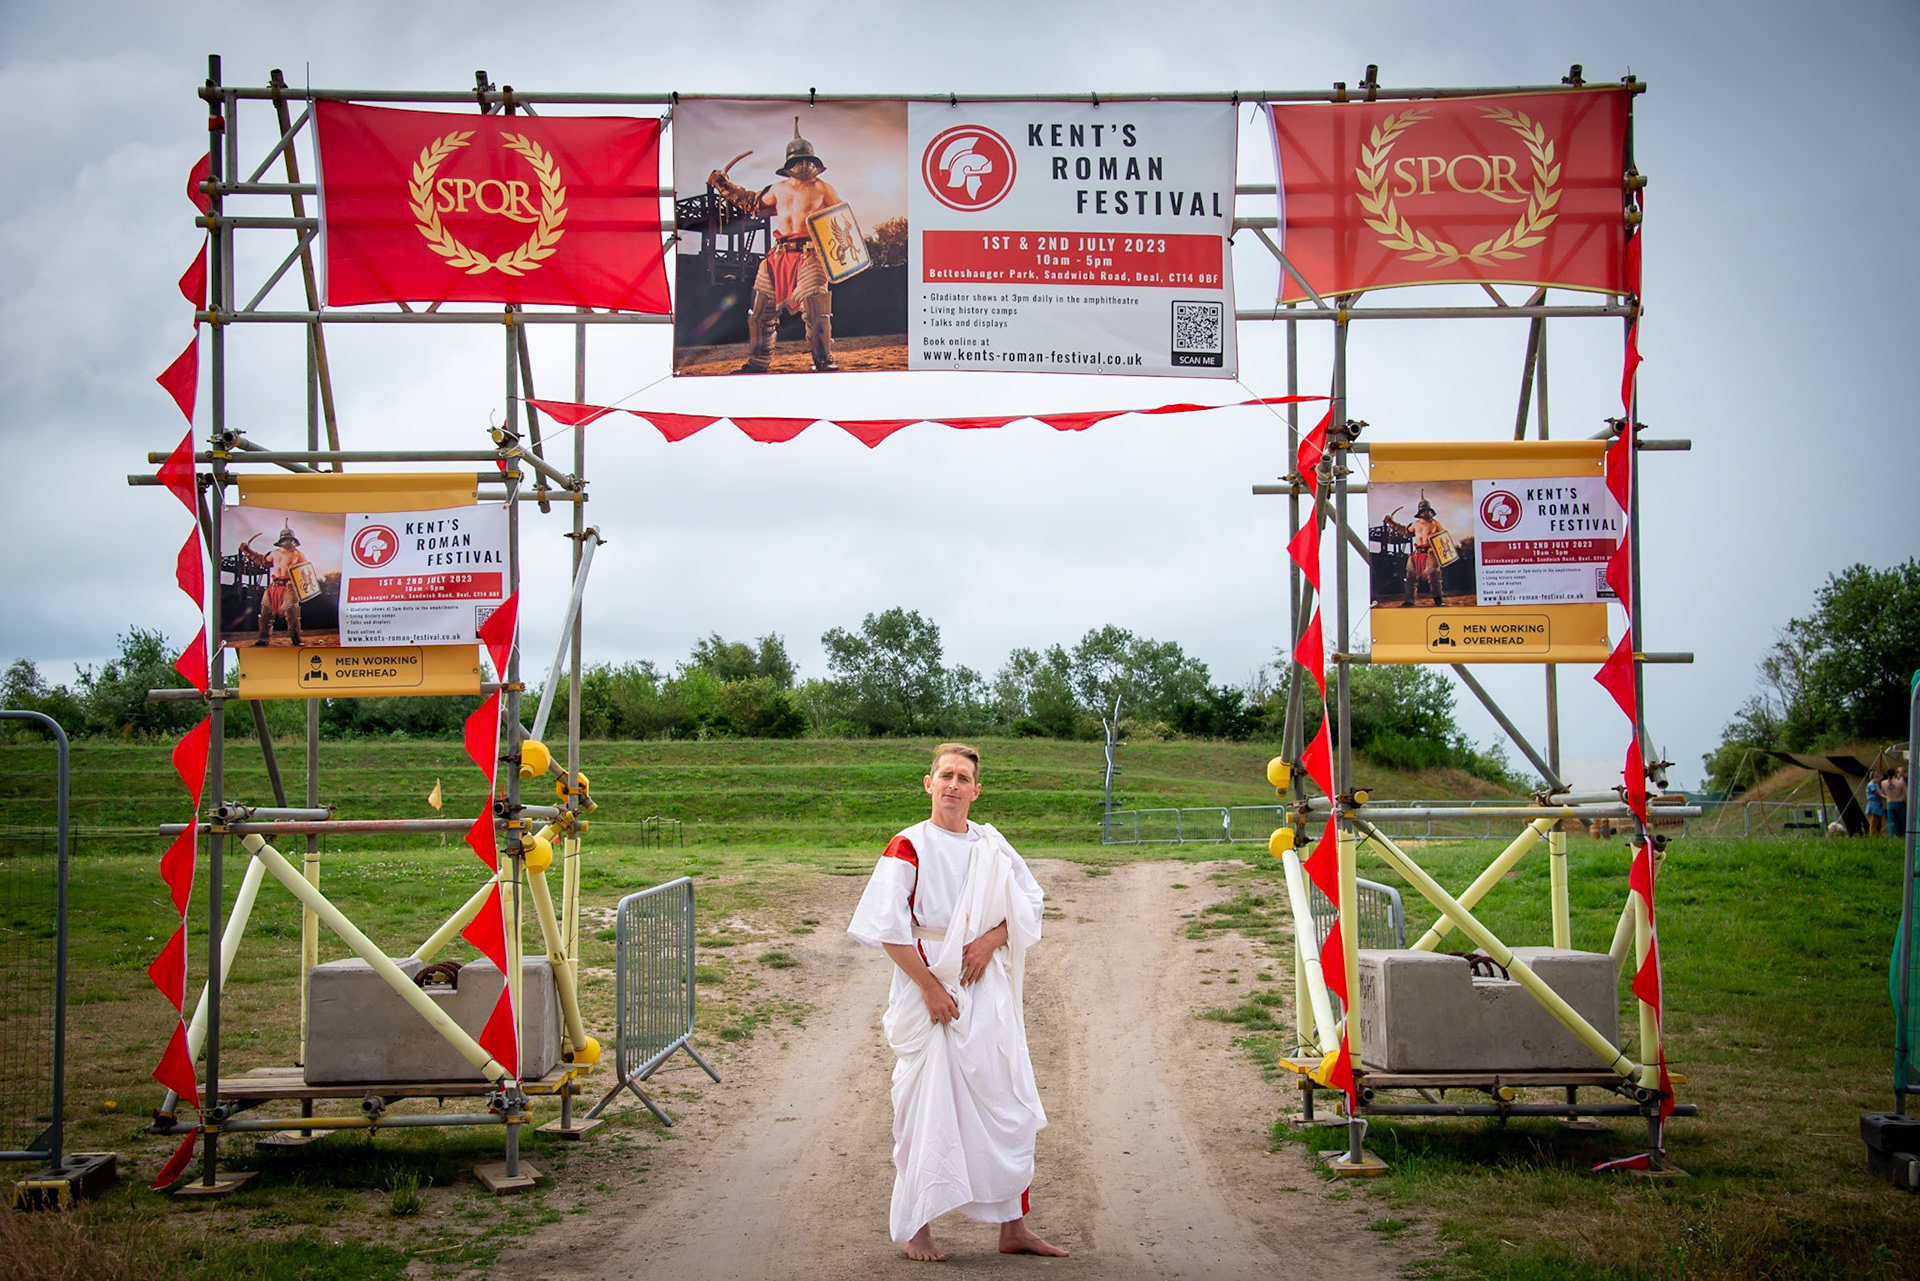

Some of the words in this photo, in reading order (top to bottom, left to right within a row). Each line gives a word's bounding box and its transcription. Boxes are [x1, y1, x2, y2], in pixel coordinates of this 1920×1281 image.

[1028, 124, 1137, 147] KENT'S
[1052, 157, 1162, 180] ROMAN
[1394, 154, 1530, 204] SPQR
[436, 178, 541, 223] SPQR
[1077, 190, 1222, 218] FESTIVAL
[982, 236, 1010, 250] 1ST
[1020, 236, 1028, 250] &
[1038, 237, 1069, 250] 2ND
[1078, 238, 1115, 252] JULY
[1124, 238, 1166, 253] 2023
[1036, 254, 1070, 265] 10am
[1086, 255, 1112, 268] 5pm
[930, 268, 1004, 280] Betteshanger
[1010, 269, 1038, 280] Park,
[1044, 270, 1095, 280] Sandwich
[1100, 271, 1130, 282] Road,
[1136, 272, 1164, 283] Deal,
[1168, 273, 1194, 282] CT14
[930, 292, 969, 301] Gladiator
[972, 293, 997, 302] shows
[1000, 294, 1008, 302] at
[1012, 294, 1029, 303] 3pm
[1032, 294, 1052, 304] daily
[1056, 294, 1064, 302] in
[1067, 294, 1080, 303] the
[1084, 296, 1138, 305] amphitheatre
[930, 306, 955, 315] Living
[959, 306, 988, 316] history
[992, 308, 1018, 316] camps
[930, 318, 952, 327] Talks
[956, 318, 970, 327] and
[974, 319, 1008, 328] displays
[924, 337, 945, 346] Book
[949, 337, 976, 346] online
[980, 338, 990, 346] at
[924, 348, 1142, 366] www.kents-roman-festival.co.uk
[1180, 356, 1200, 364] SCAN
[1203, 356, 1216, 365] ME
[1527, 488, 1578, 500] KENT'S
[1538, 503, 1590, 516] ROMAN
[406, 518, 459, 534] KENT'S
[1550, 518, 1617, 532] FESTIVAL
[416, 534, 470, 550] ROMAN
[1552, 541, 1570, 549] JULY
[1572, 540, 1593, 548] 2023
[428, 550, 502, 566] FESTIVAL
[427, 576, 446, 584] JULY
[450, 575, 472, 583] 2023
[1464, 624, 1487, 633] MEN
[1490, 624, 1544, 633] WORKING
[1464, 636, 1524, 644] OVERHEAD
[336, 657, 360, 666] MEN
[363, 656, 418, 665] WORKING
[336, 668, 398, 678] OVERHEAD
